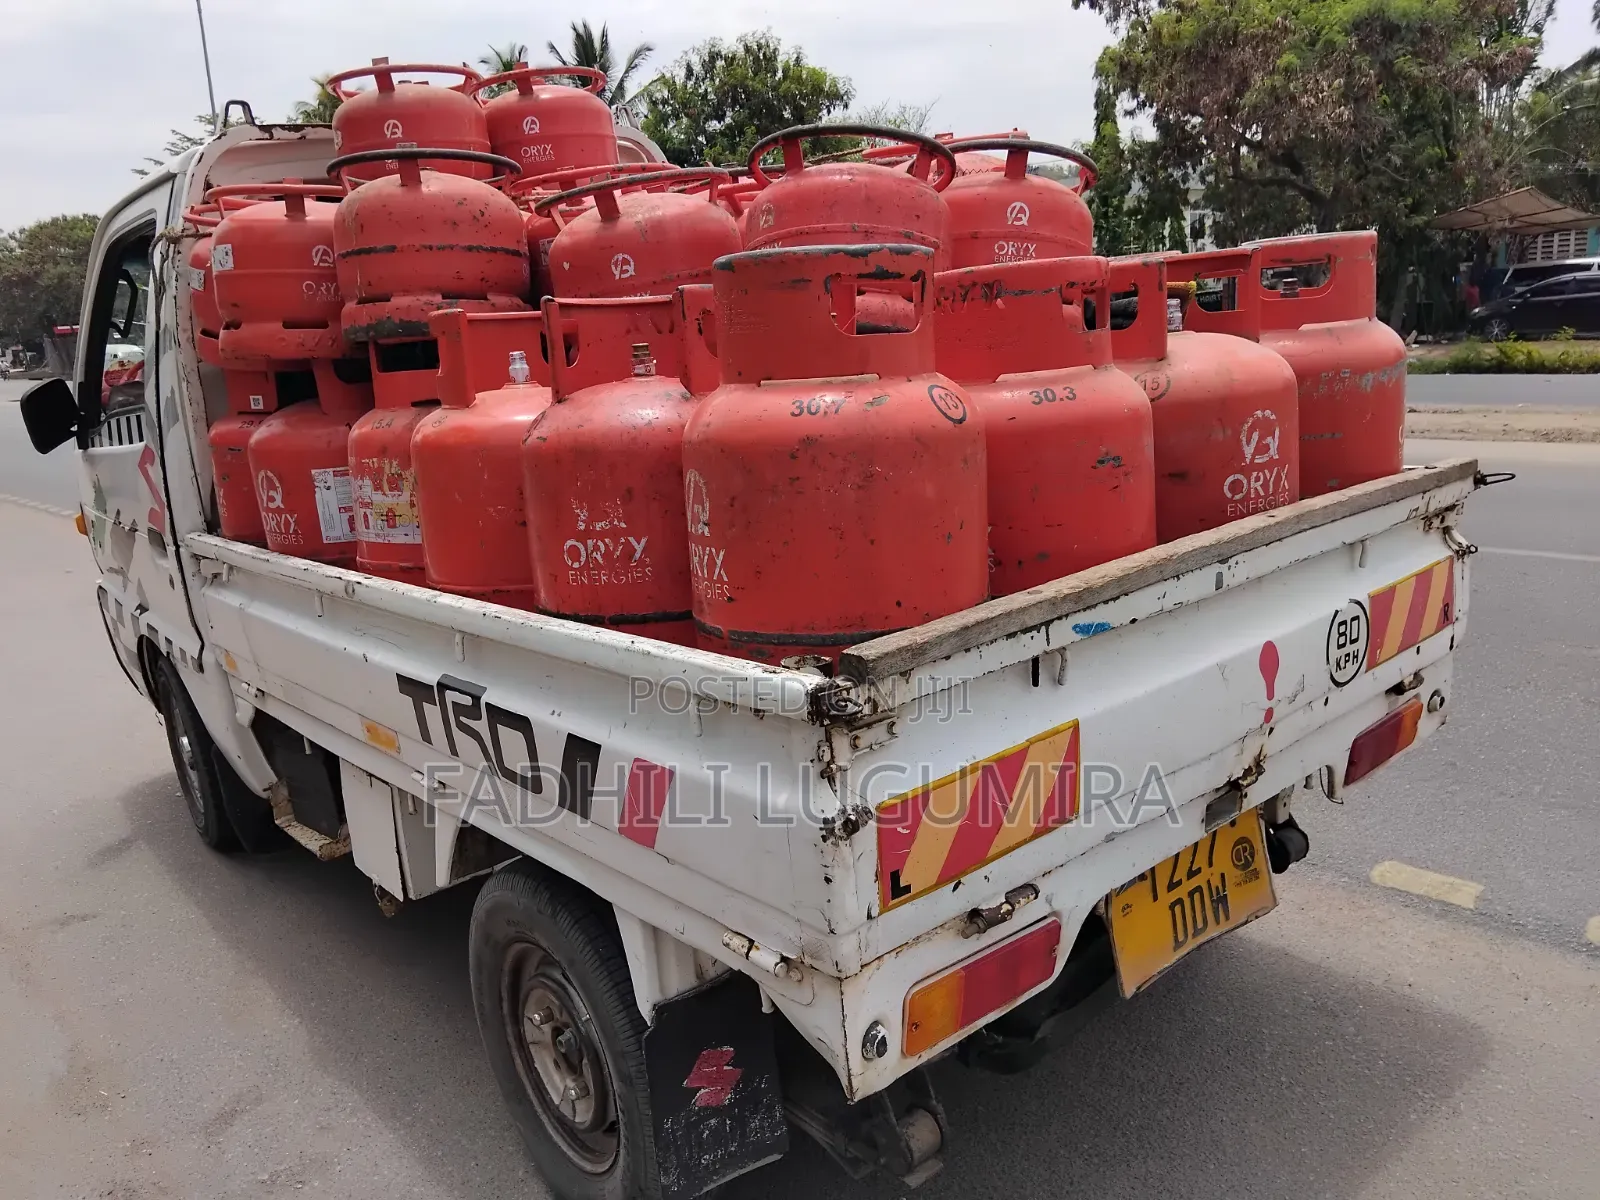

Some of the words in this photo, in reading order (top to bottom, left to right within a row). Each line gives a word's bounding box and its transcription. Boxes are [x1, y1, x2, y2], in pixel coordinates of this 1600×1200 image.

[521, 144, 553, 157] ORYX
[523, 155, 555, 163] ENERGIES
[994, 241, 1037, 257] ORYX
[303, 281, 341, 295] ORY
[1029, 386, 1077, 406] 30.3
[1223, 464, 1289, 500] ORYX
[1337, 615, 1360, 650] 80
[1335, 649, 1359, 673] KPH
[889, 869, 912, 901] L
[1169, 872, 1231, 952] DDW
